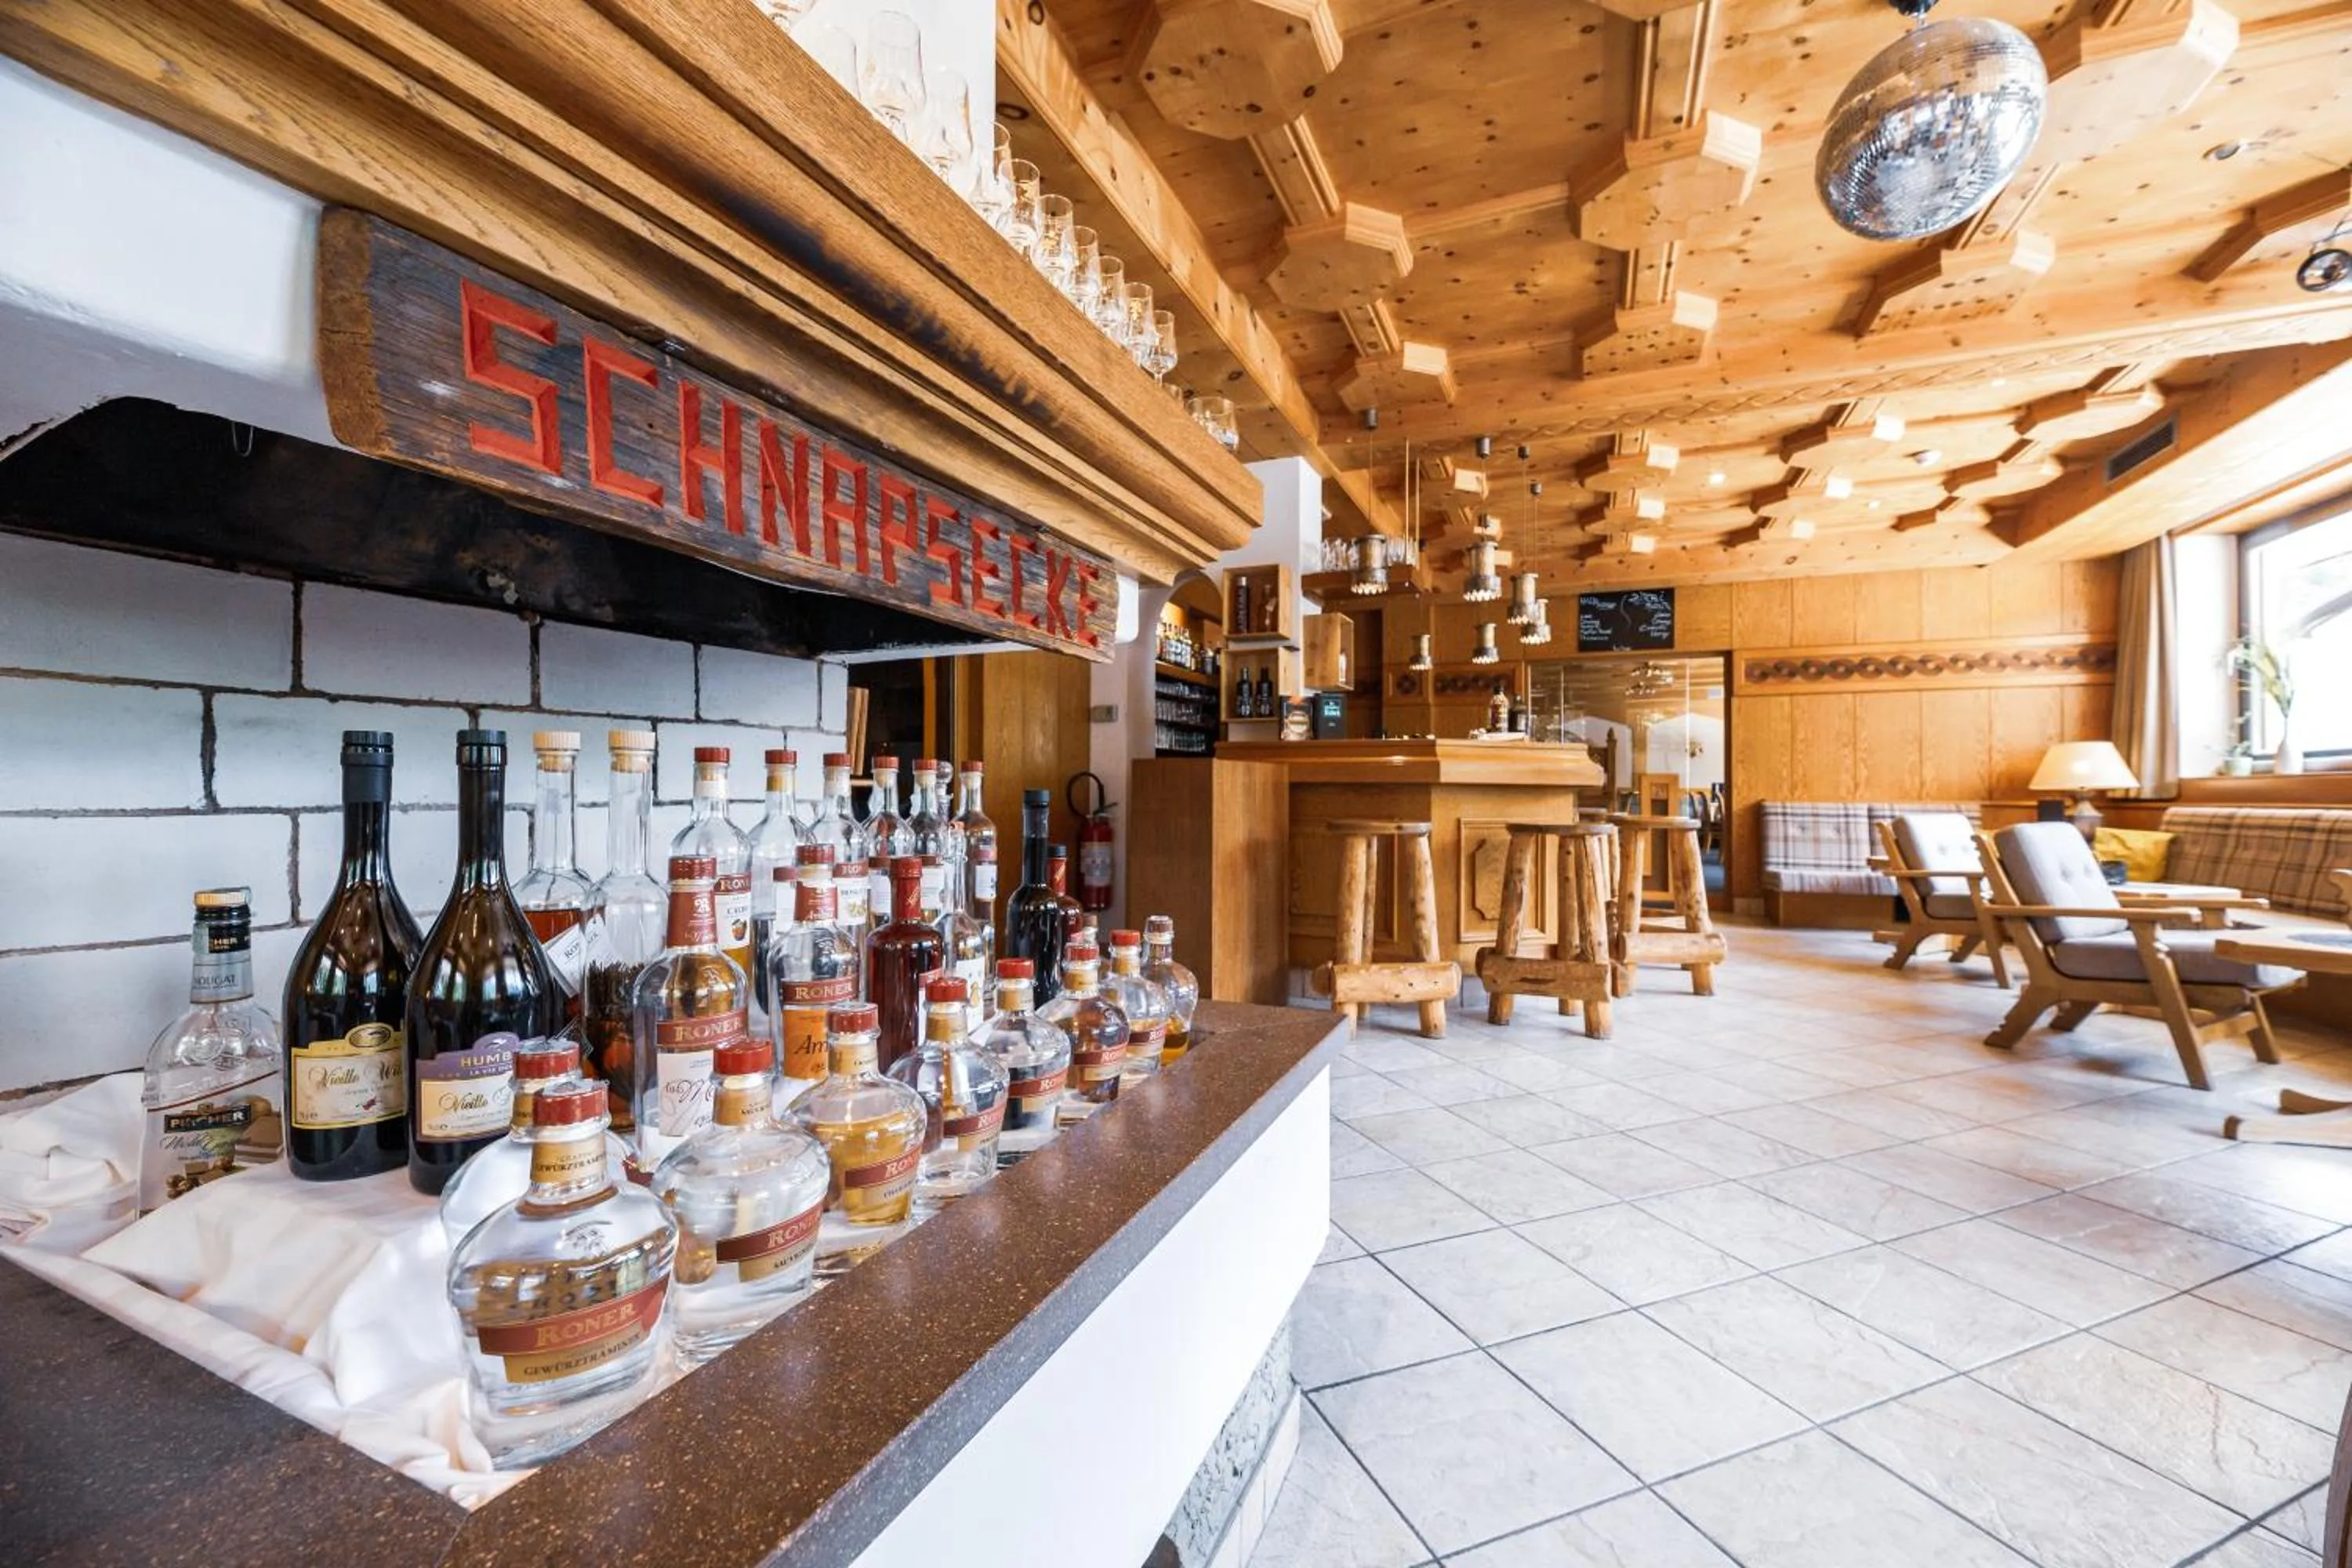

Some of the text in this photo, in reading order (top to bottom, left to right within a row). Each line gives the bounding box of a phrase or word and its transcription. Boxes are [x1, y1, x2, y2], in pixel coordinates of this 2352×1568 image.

[461, 278, 1099, 647] SCHNAPSECKE
[795, 981, 853, 1000] RONER
[536, 1302, 635, 1347] RONER
